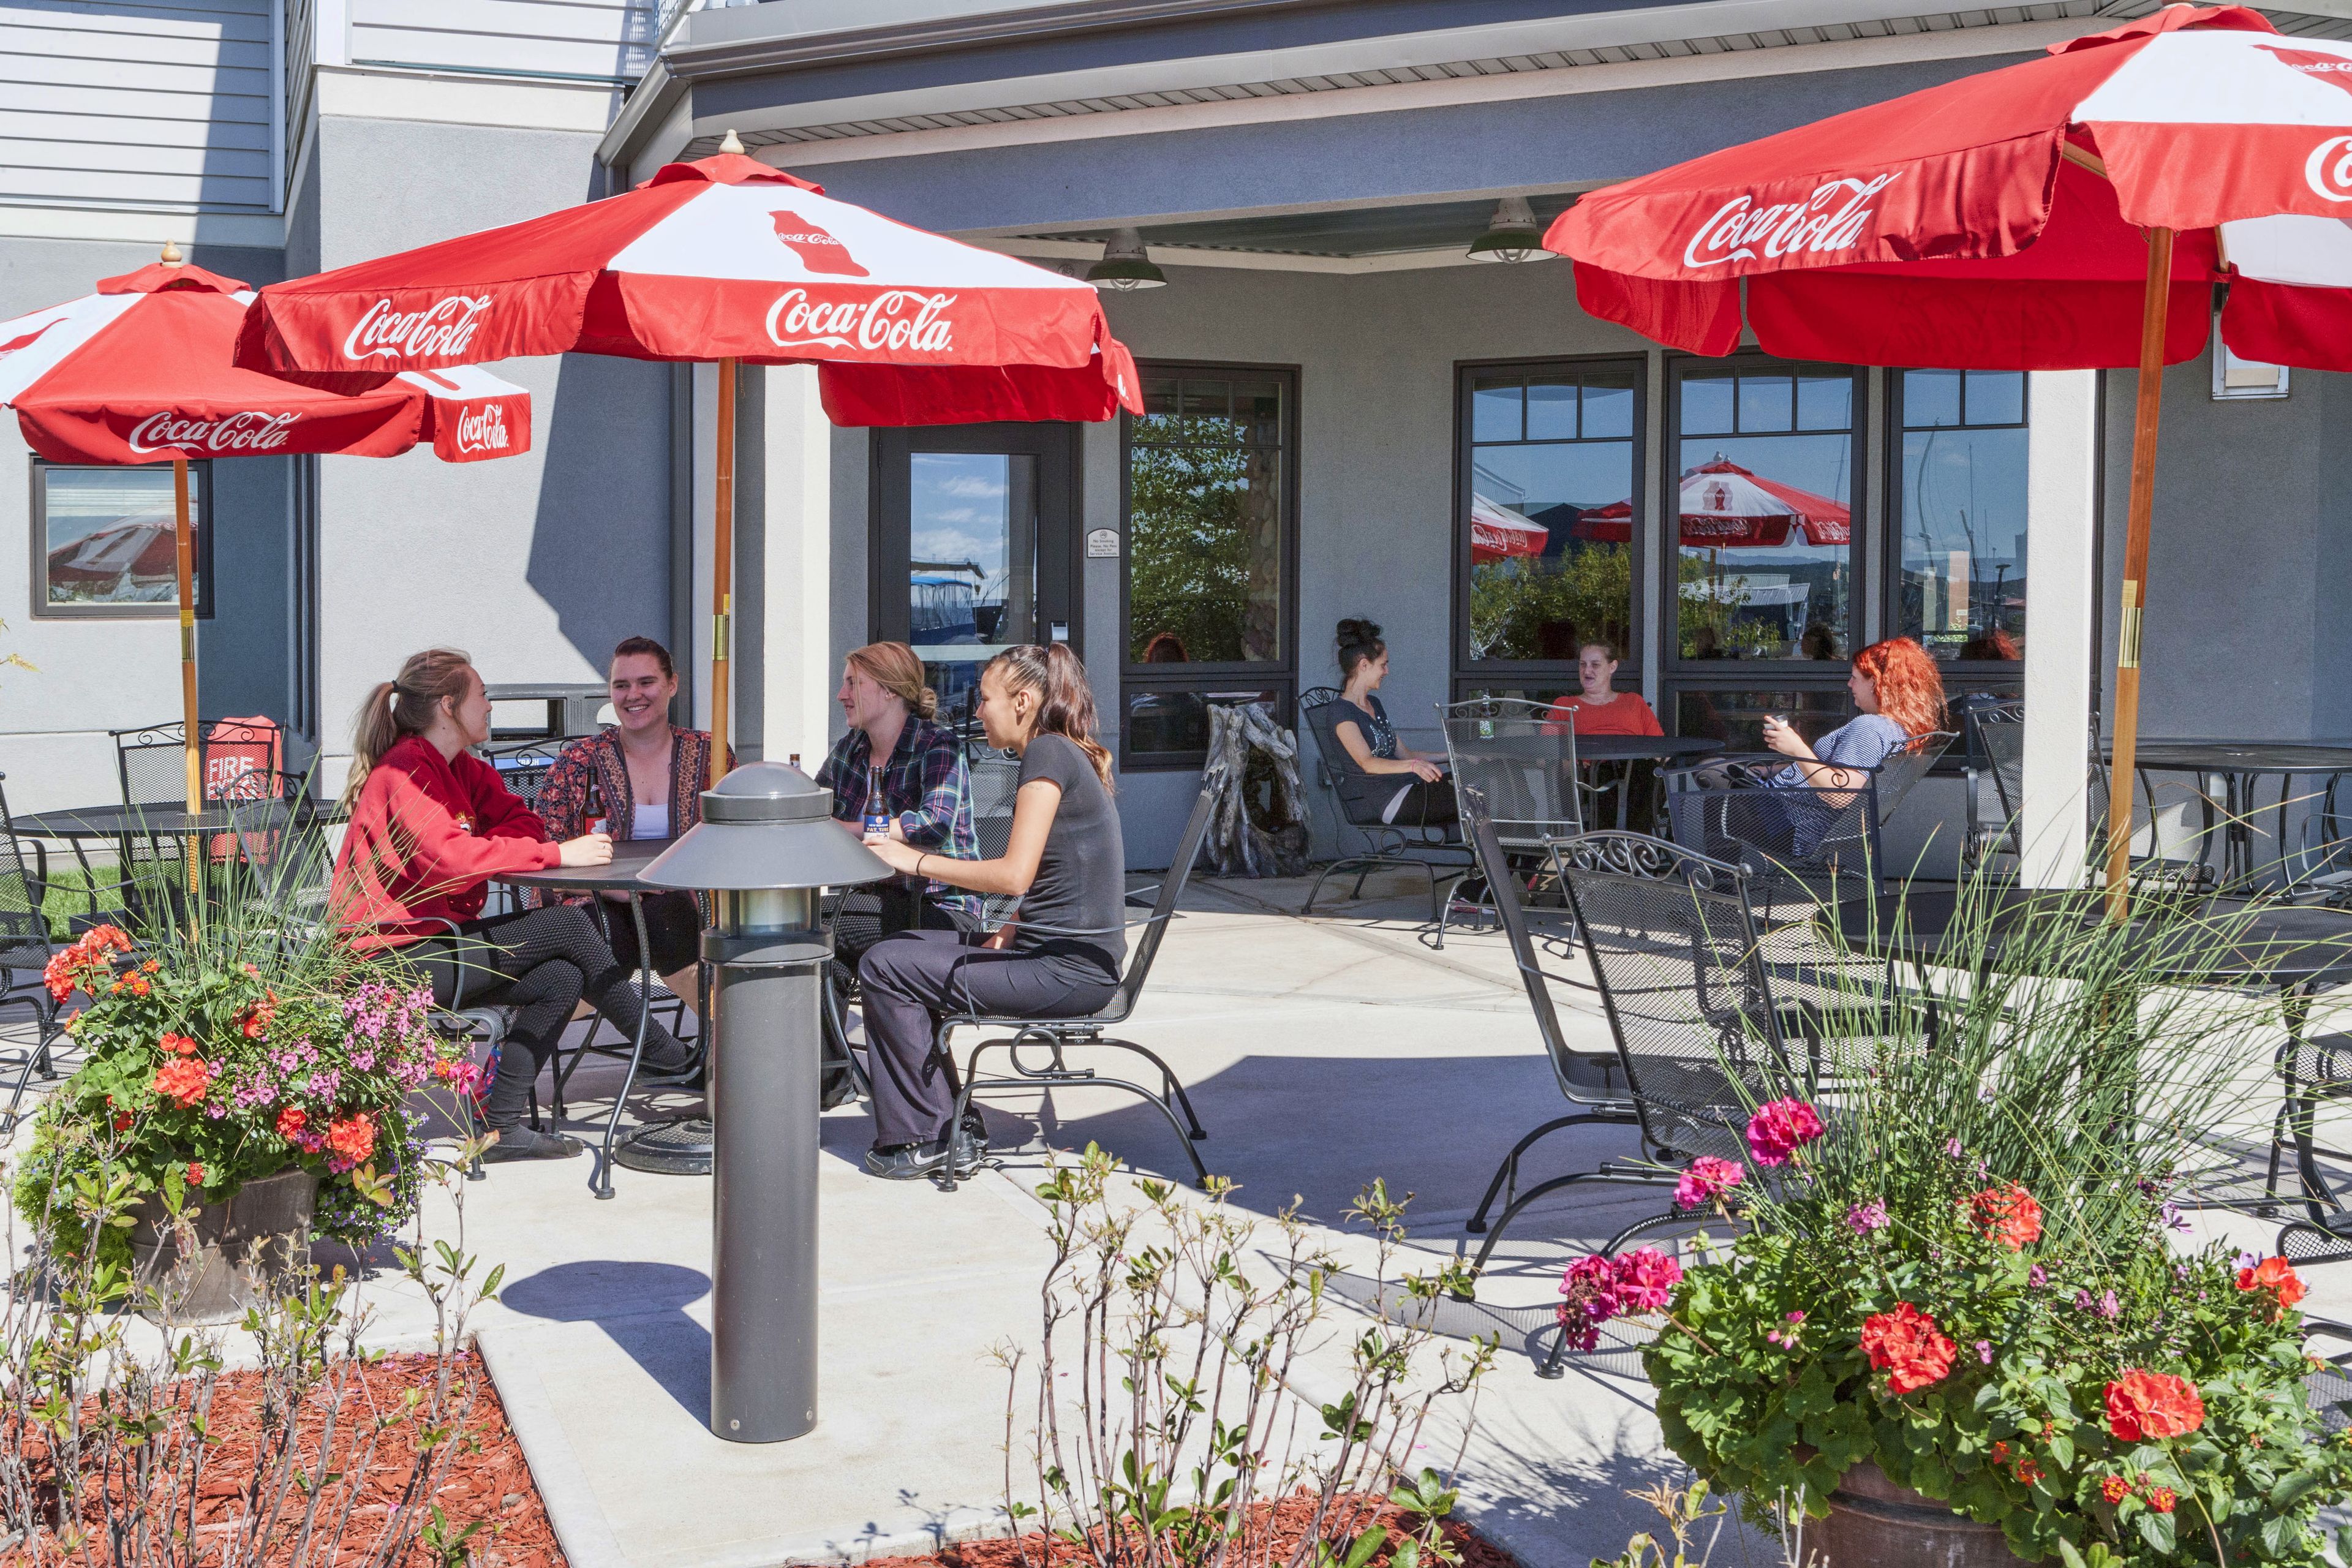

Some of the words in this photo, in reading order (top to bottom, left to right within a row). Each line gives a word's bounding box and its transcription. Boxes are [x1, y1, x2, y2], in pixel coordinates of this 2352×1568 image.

[778, 232, 842, 245] Coca-Cola
[1683, 171, 1903, 268] Coca-Cola
[343, 293, 498, 360] Coca-Cola
[766, 288, 958, 352] Coca-Cola
[129, 411, 303, 454] Coca-Cola
[458, 404, 509, 454] Coca-Cola
[209, 756, 254, 782] FIRE
